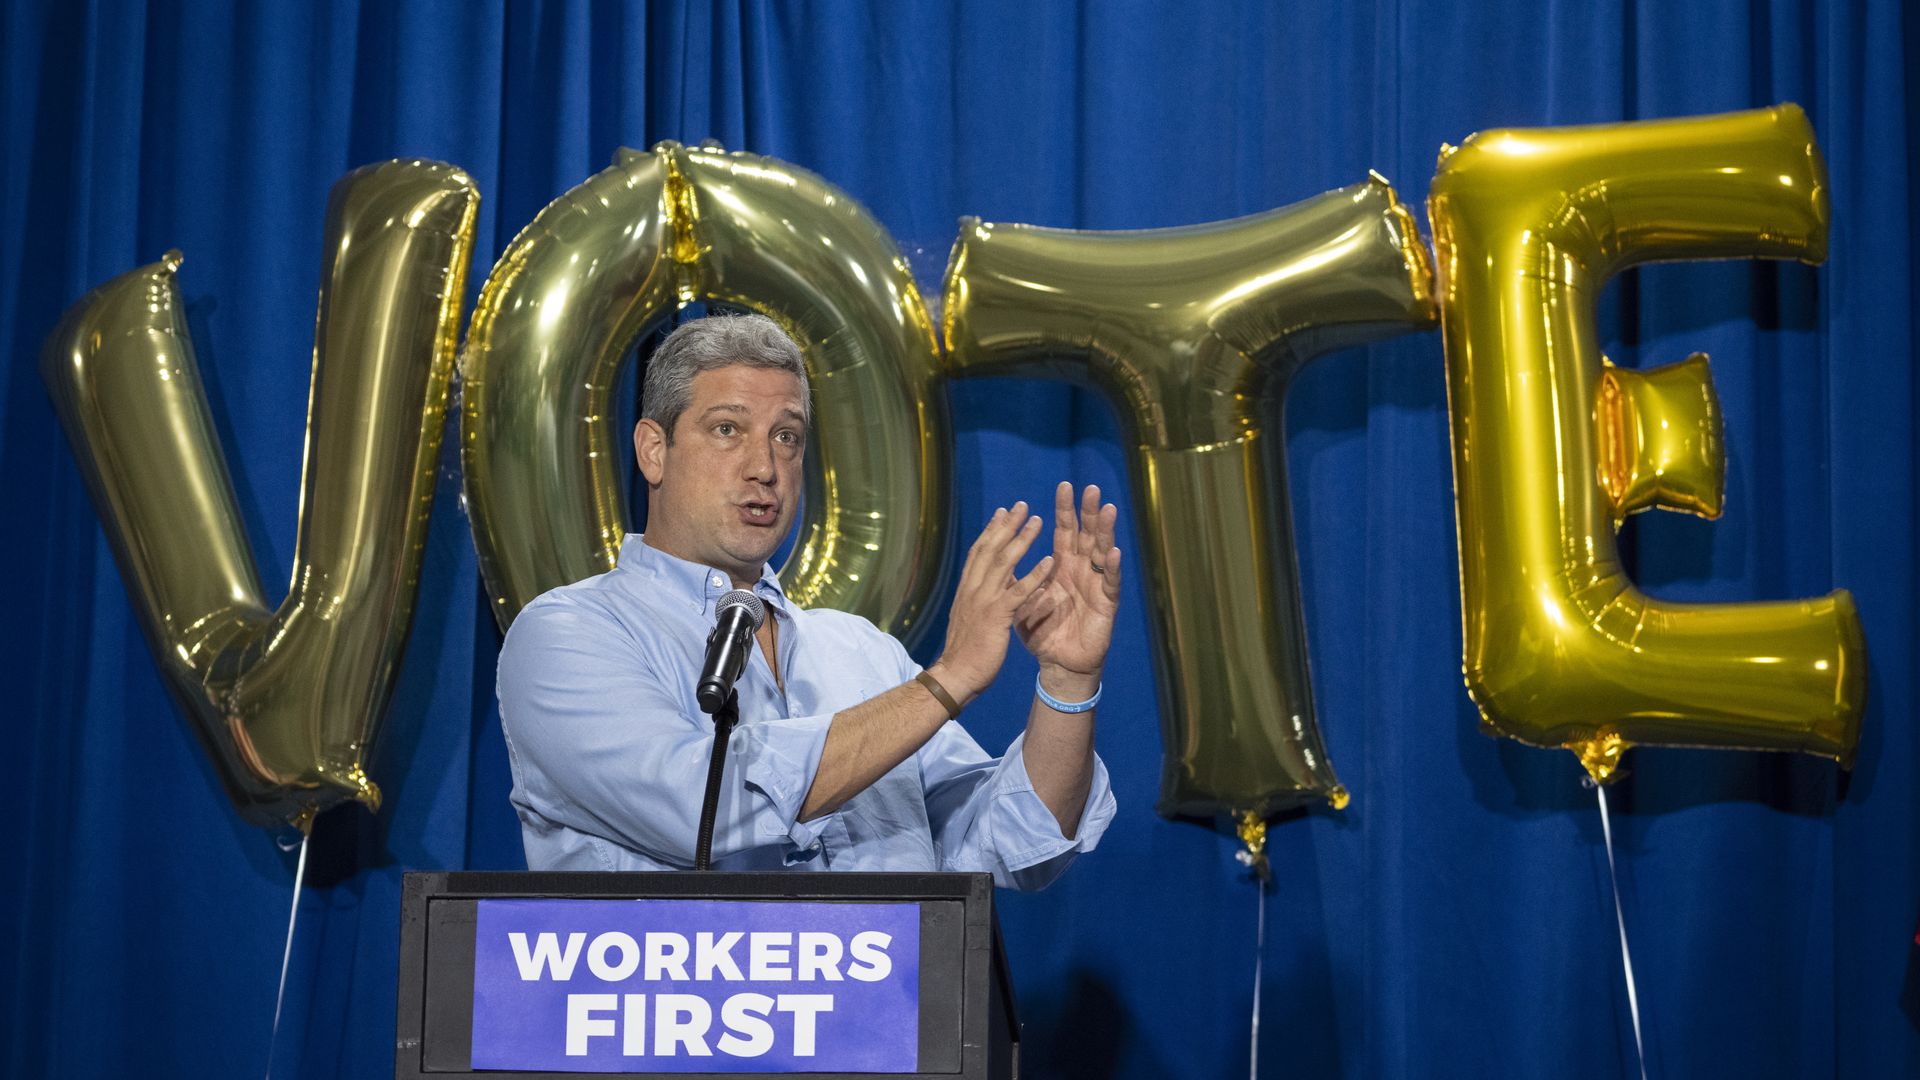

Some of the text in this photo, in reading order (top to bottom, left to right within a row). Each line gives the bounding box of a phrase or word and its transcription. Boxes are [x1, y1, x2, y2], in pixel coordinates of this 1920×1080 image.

[42, 102, 1867, 826] VOTE
[508, 931, 893, 982] WORKERS
[565, 992, 834, 1058] FIRST
